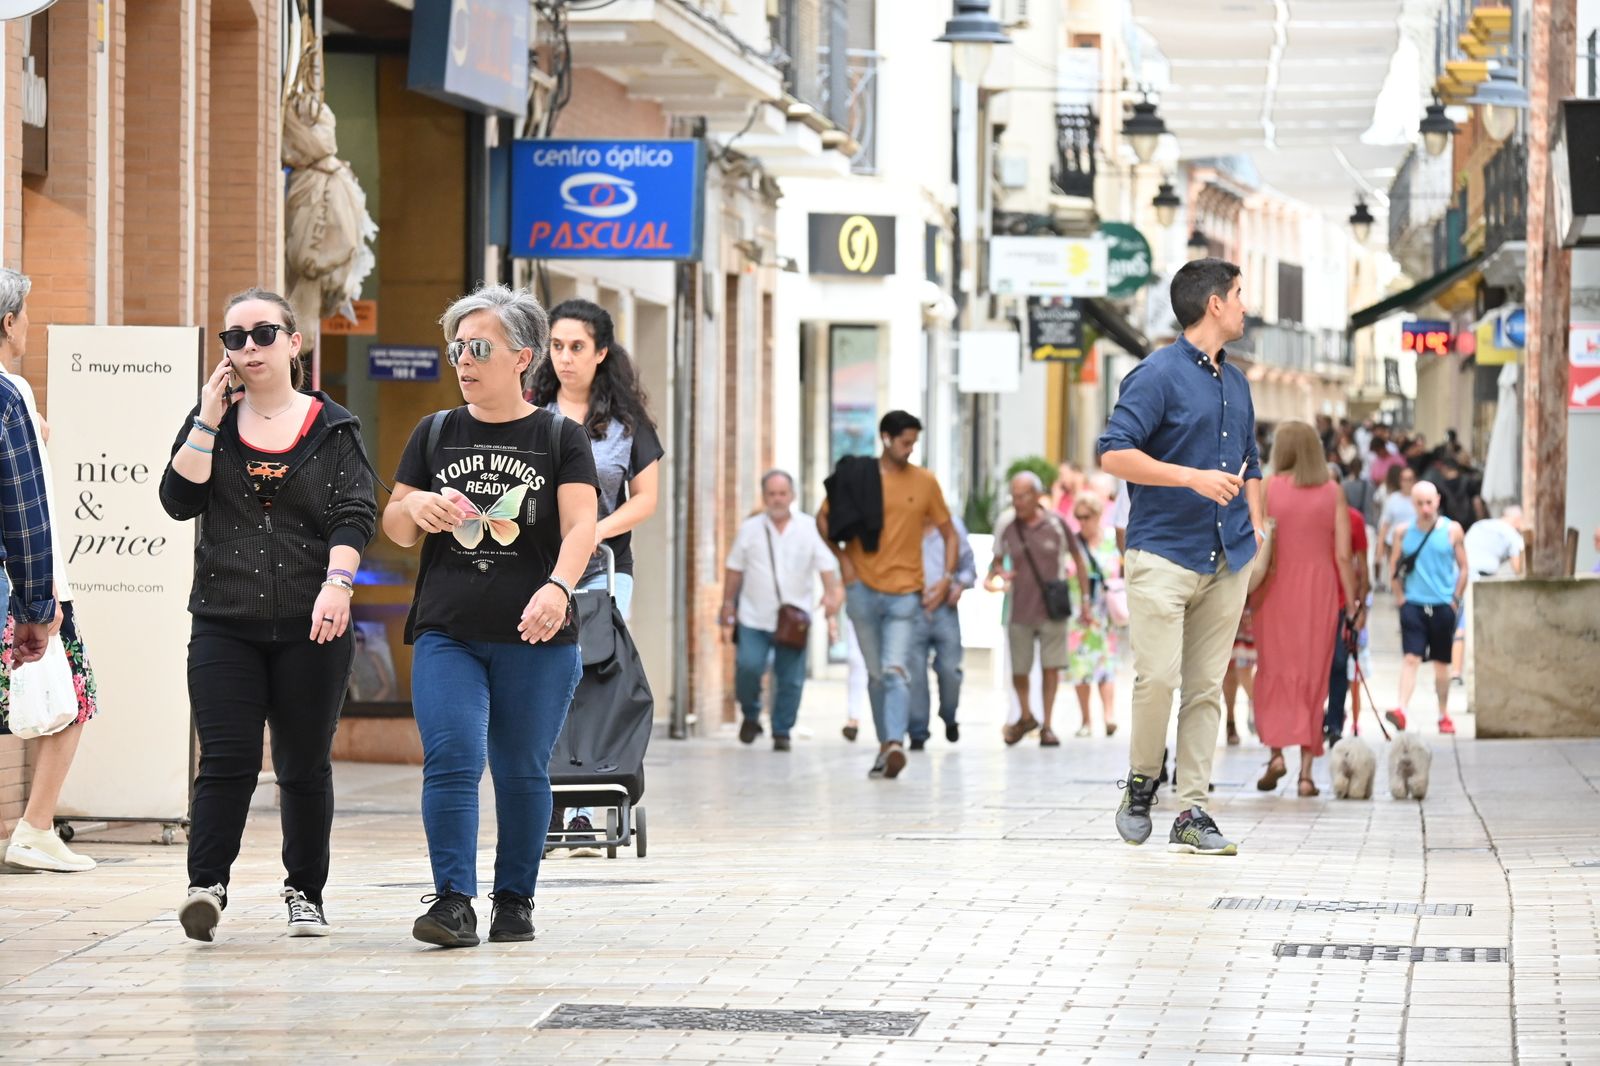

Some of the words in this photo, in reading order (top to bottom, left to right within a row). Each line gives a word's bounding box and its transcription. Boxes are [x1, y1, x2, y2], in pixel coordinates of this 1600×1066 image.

[533, 145, 600, 167] centro
[605, 144, 673, 171] óptico
[529, 221, 673, 249] PASCUAL
[88, 363, 120, 375] muy
[123, 361, 172, 373] mucho
[74, 453, 149, 484] nice
[436, 455, 485, 485] YOUR
[490, 453, 545, 491] WINGS
[480, 472, 499, 481] are
[465, 481, 510, 495] READY
[74, 490, 104, 521] &
[68, 525, 166, 564] price
[68, 582, 164, 593] muymucho.com
